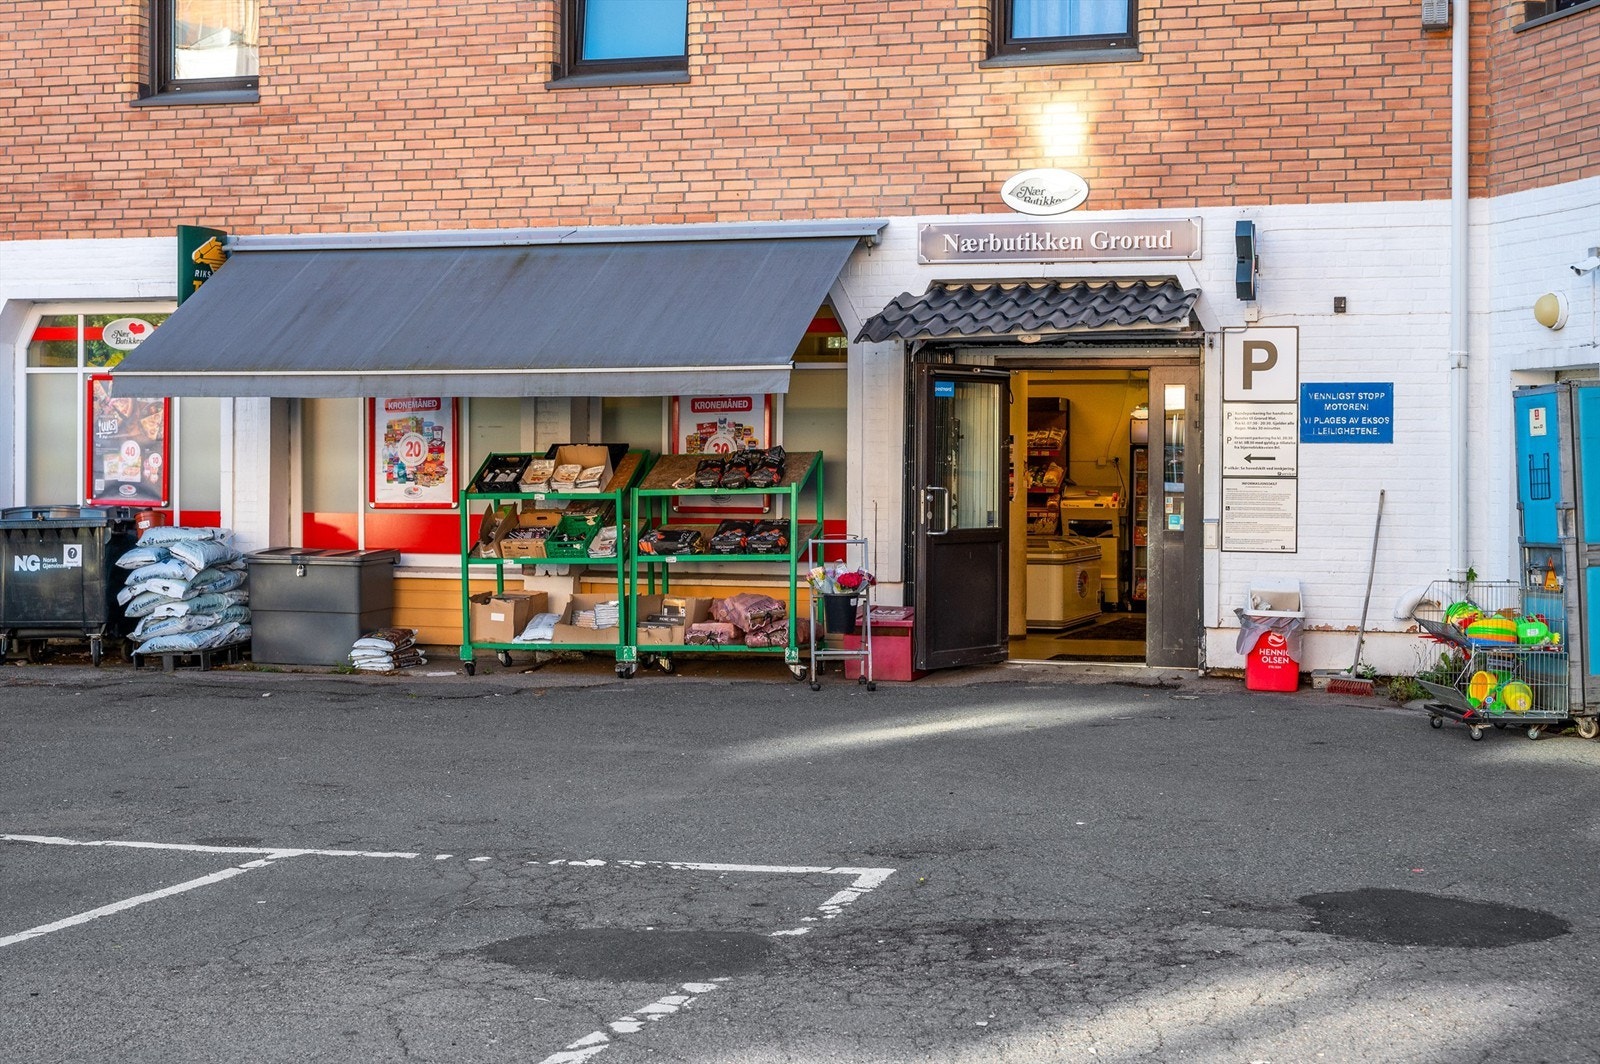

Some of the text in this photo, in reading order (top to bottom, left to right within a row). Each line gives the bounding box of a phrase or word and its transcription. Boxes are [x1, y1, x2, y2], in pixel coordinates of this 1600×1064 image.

[1016, 186, 1046, 198] Nær
[943, 230, 1172, 253] Nærbutikken Grorud
[194, 270, 211, 278] RIKS
[111, 330, 130, 339] Nær
[1242, 340, 1278, 390] P
[388, 399, 438, 410] KRONEMÅNED
[694, 398, 748, 410] KRONEMÅNED
[126, 446, 135, 456] 40
[406, 441, 421, 457] 20
[712, 442, 730, 454] 30
[14, 554, 40, 572] NG
[1262, 656, 1289, 664] OLSEN
